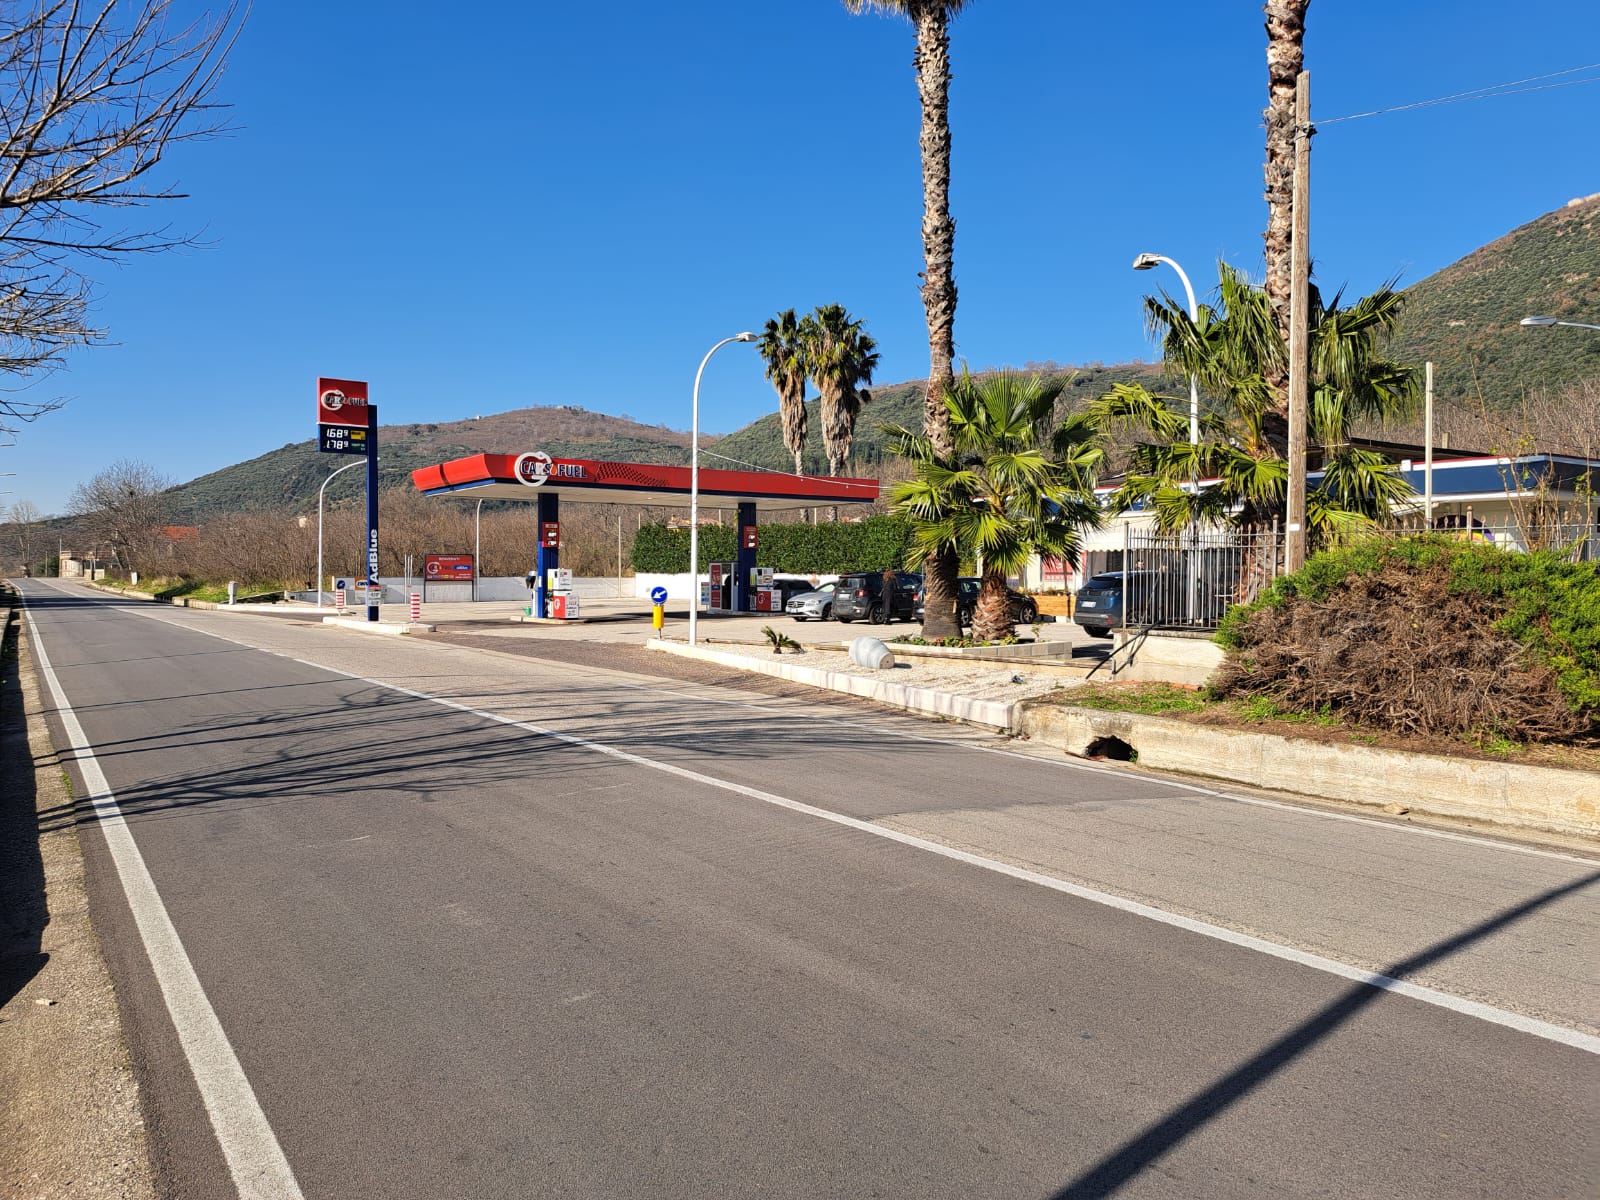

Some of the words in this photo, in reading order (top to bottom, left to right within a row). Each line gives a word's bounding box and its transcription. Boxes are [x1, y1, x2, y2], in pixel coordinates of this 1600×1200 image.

[520, 461, 551, 476] CARS
[557, 463, 588, 478] FUEL
[369, 528, 379, 584] AdBlue
